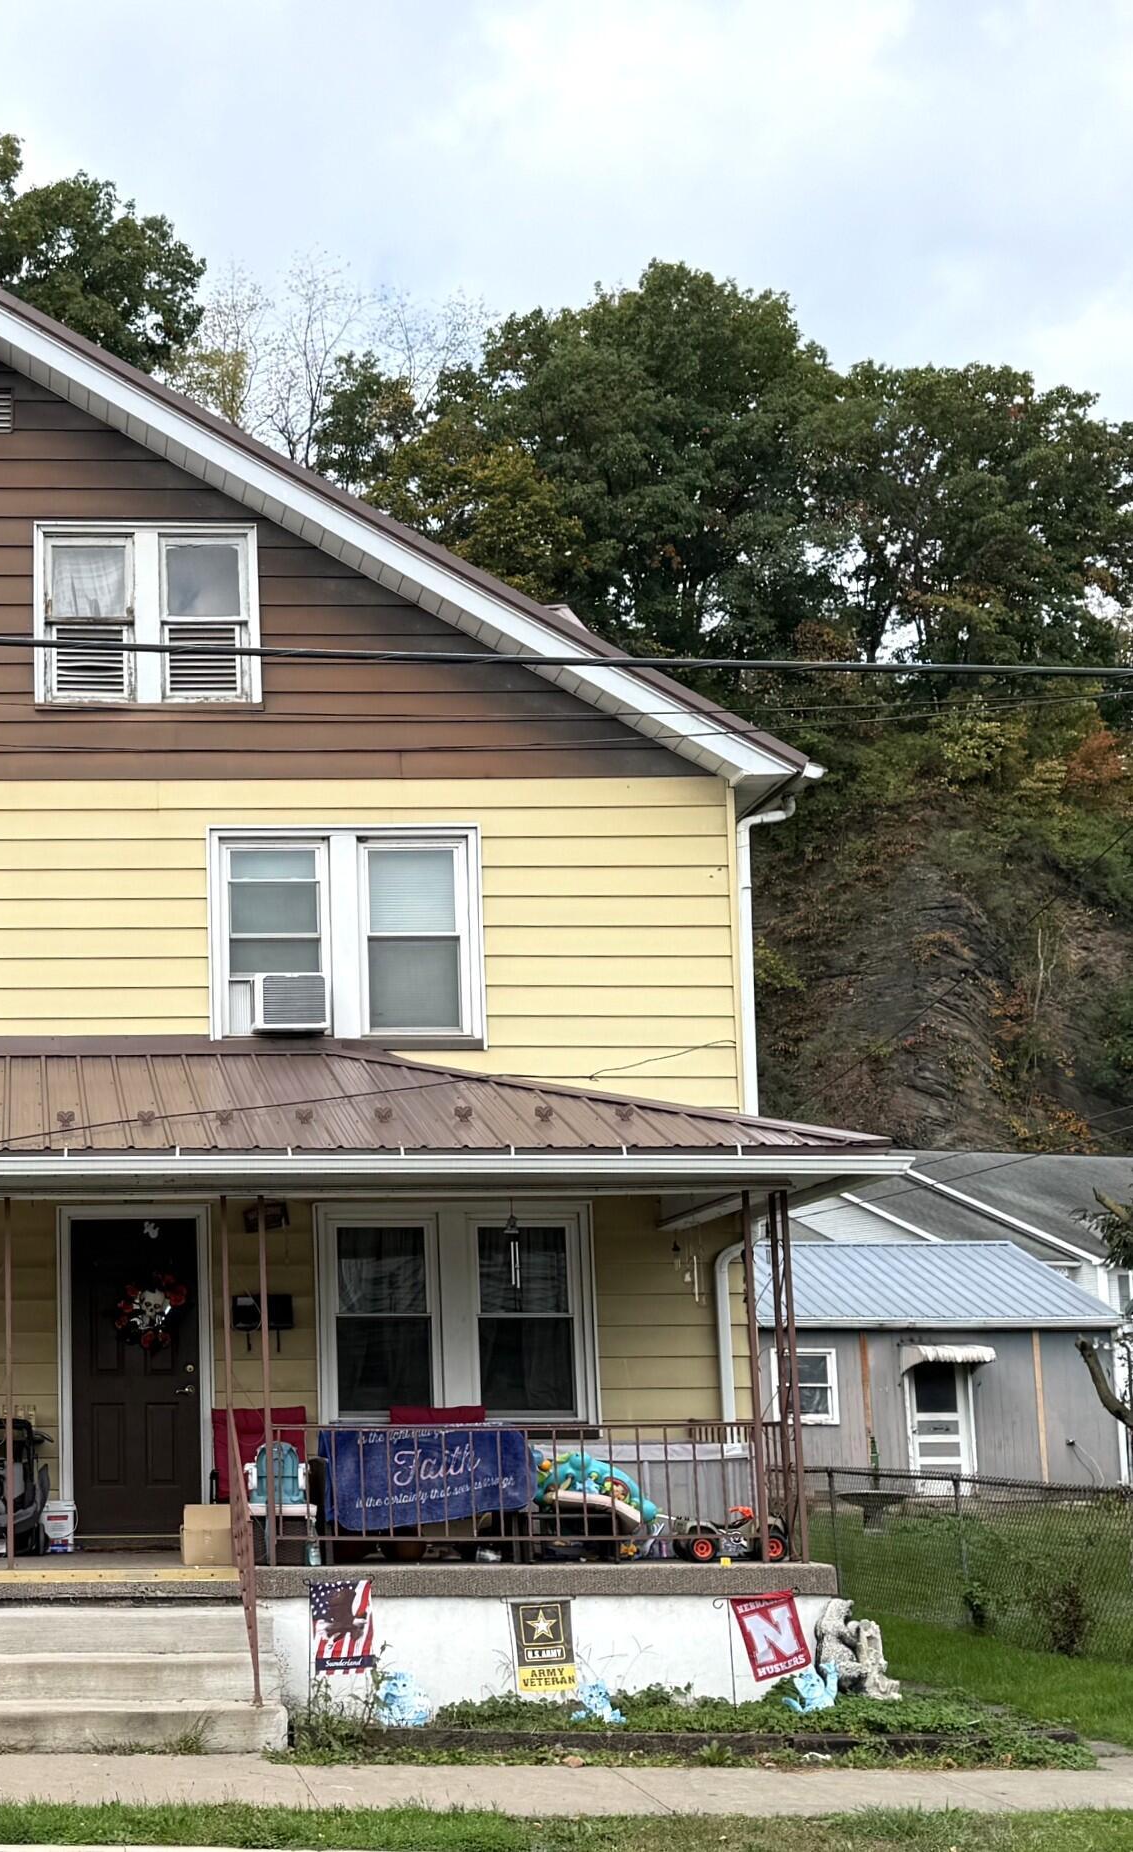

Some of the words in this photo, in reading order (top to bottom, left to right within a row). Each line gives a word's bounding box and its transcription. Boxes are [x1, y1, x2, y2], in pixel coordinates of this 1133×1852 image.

[393, 1443, 481, 1486] Faith
[365, 1495, 383, 1507] the
[429, 1487, 451, 1499] that
[736, 1599, 780, 1614] NEBRA
[742, 1603, 801, 1665] N
[325, 1658, 363, 1667] Sunderland
[756, 1654, 806, 1677] HUSKERS
[522, 1675, 576, 1687] VETERAN
[530, 1667, 565, 1678] ARMY
